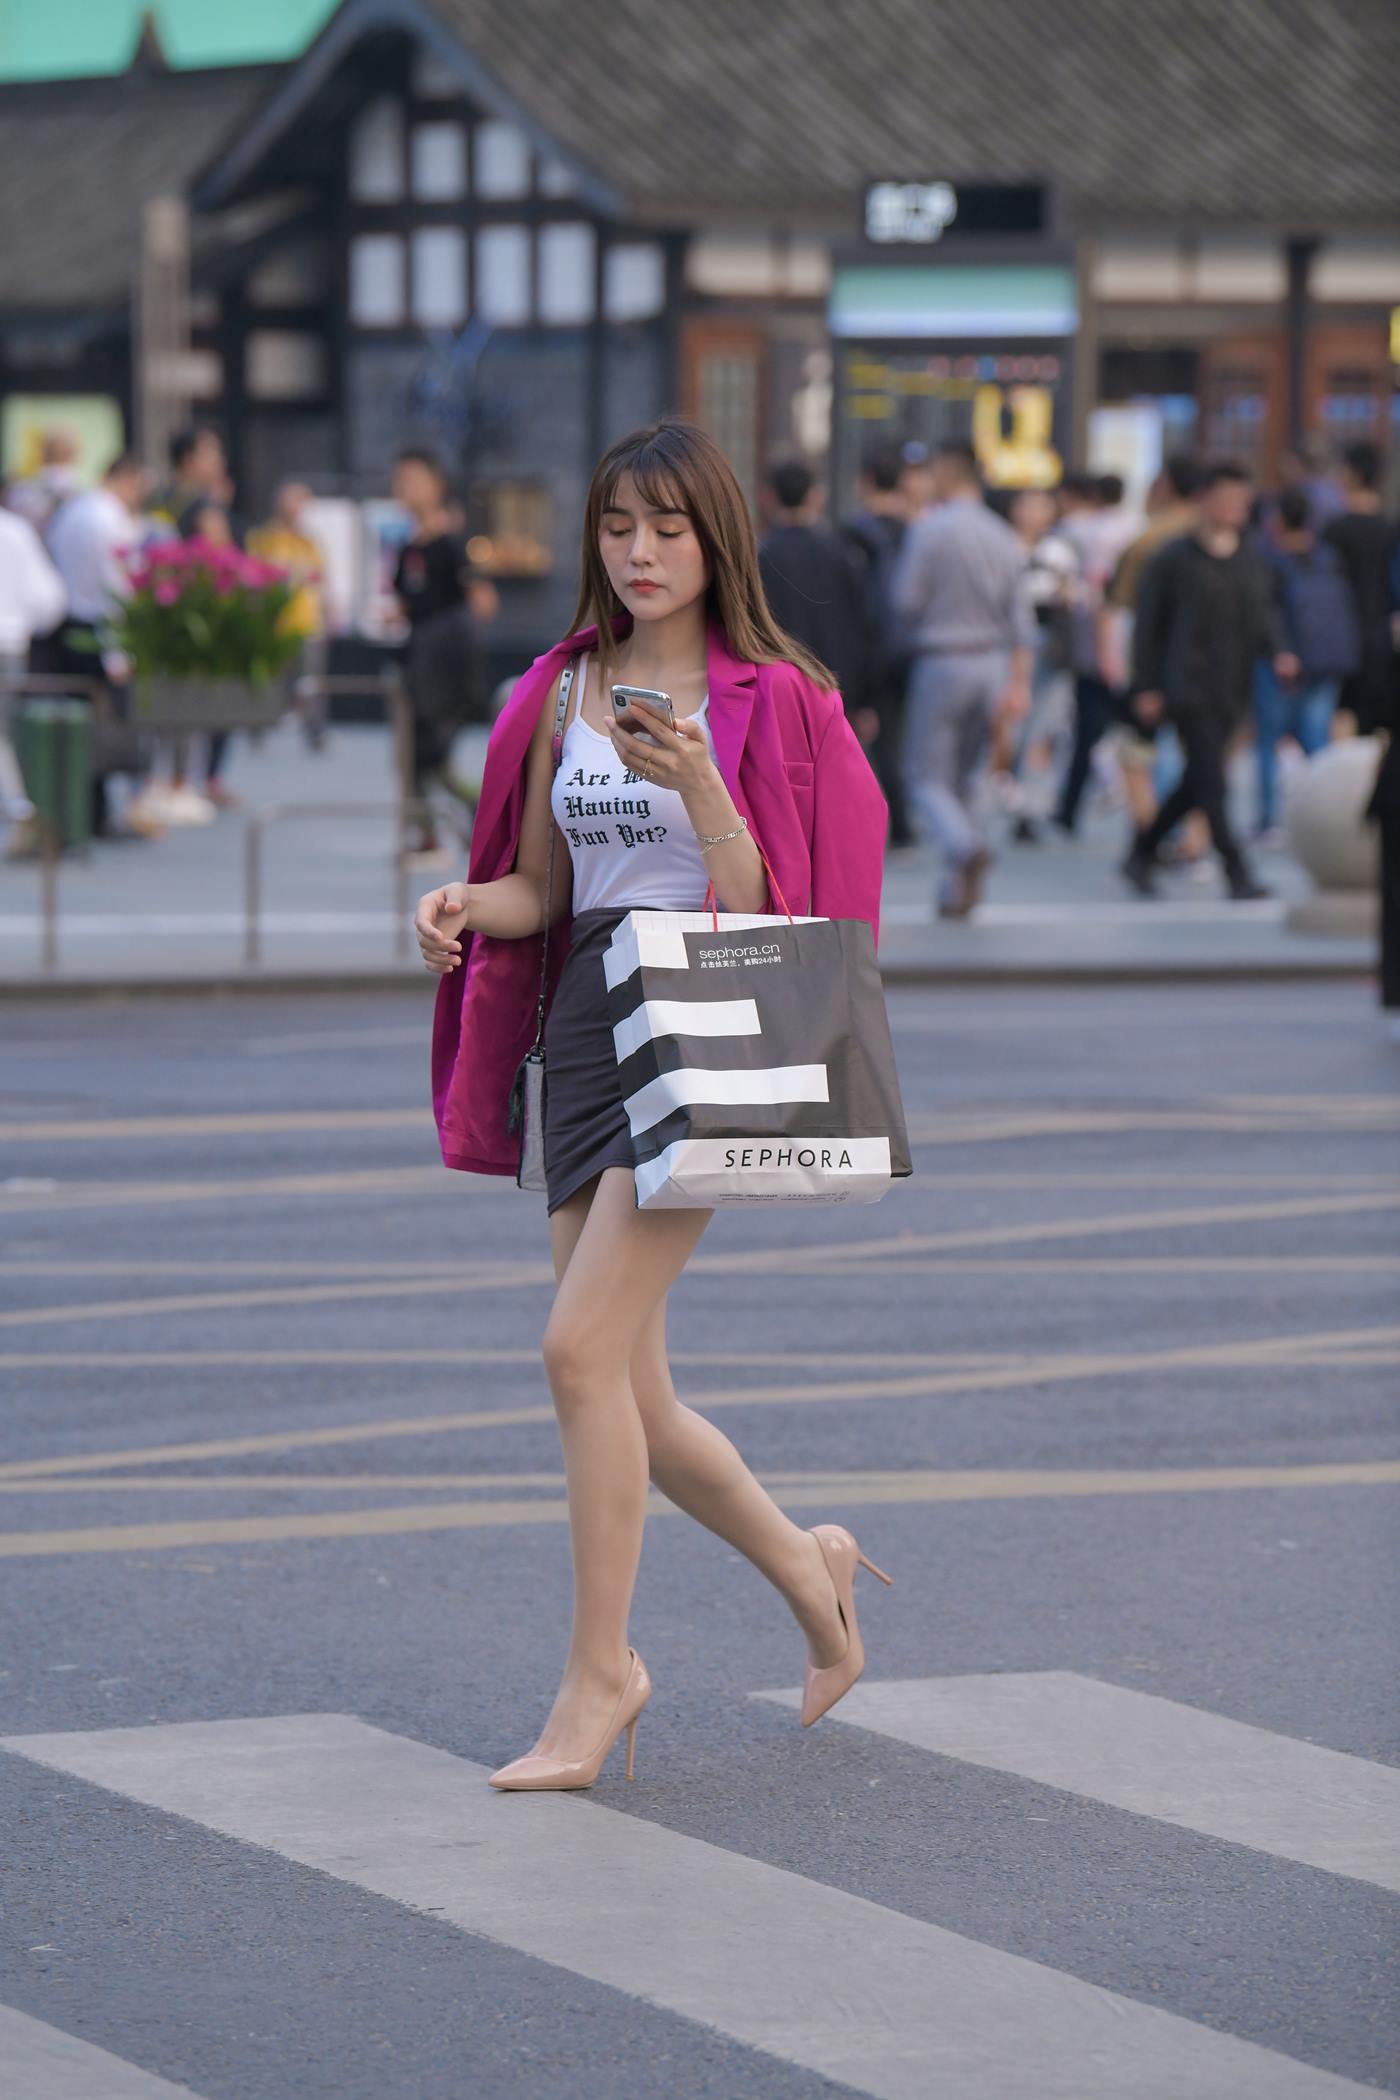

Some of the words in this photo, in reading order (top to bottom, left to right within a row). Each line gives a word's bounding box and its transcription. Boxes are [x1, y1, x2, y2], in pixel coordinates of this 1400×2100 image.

[565, 768, 611, 787] Are
[566, 828, 609, 848] Fun
[616, 823, 668, 849] Yet?
[699, 944, 780, 960] sephora.cn
[725, 1148, 853, 1168] SEPHORA
